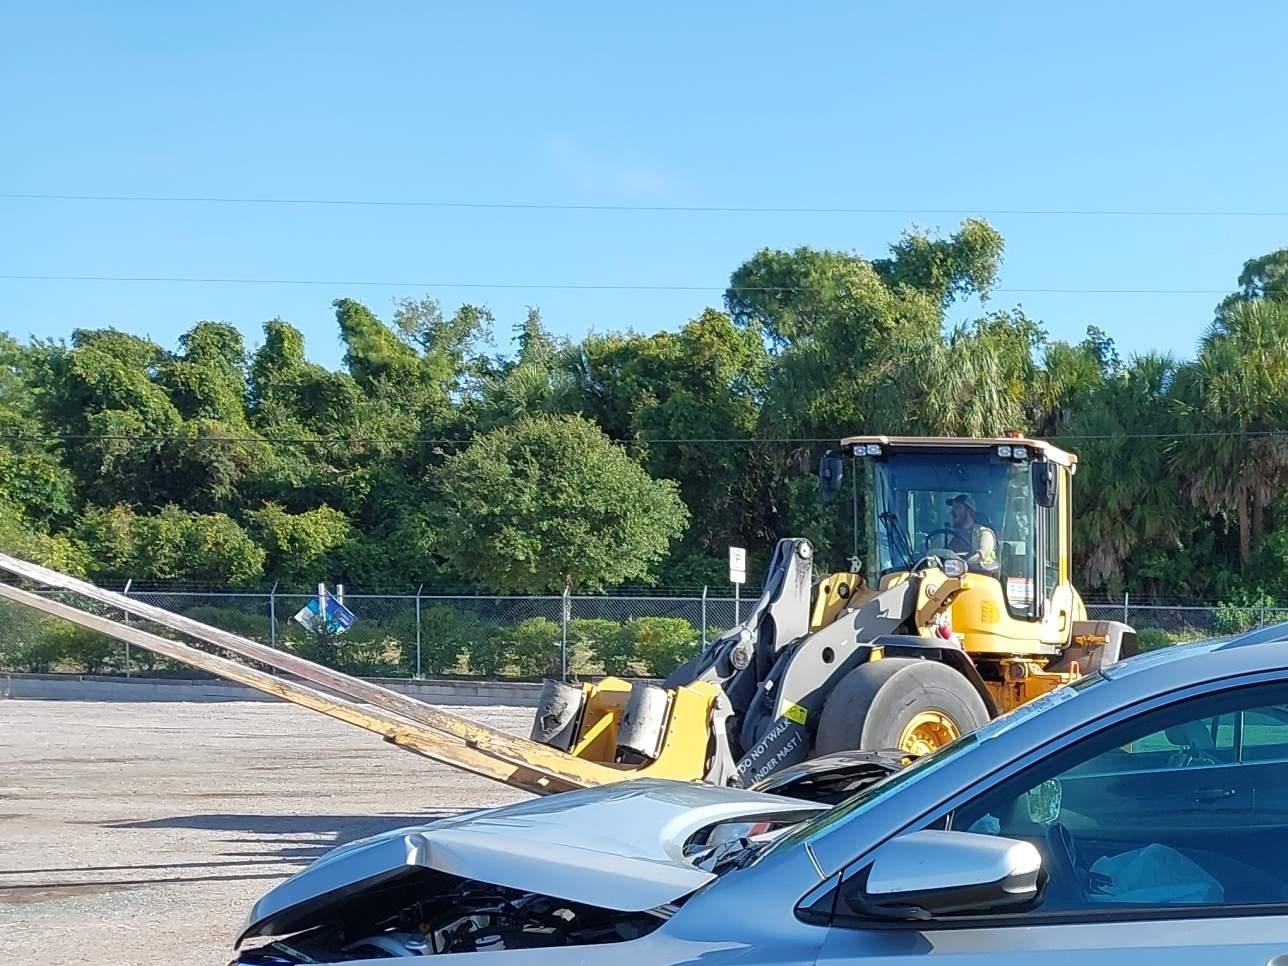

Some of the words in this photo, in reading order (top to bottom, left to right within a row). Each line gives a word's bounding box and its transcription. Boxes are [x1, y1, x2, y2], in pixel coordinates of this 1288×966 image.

[738, 758, 752, 775] DO
[750, 738, 769, 760] NOT
[766, 718, 791, 743] WALK
[751, 759, 778, 784] UNDER
